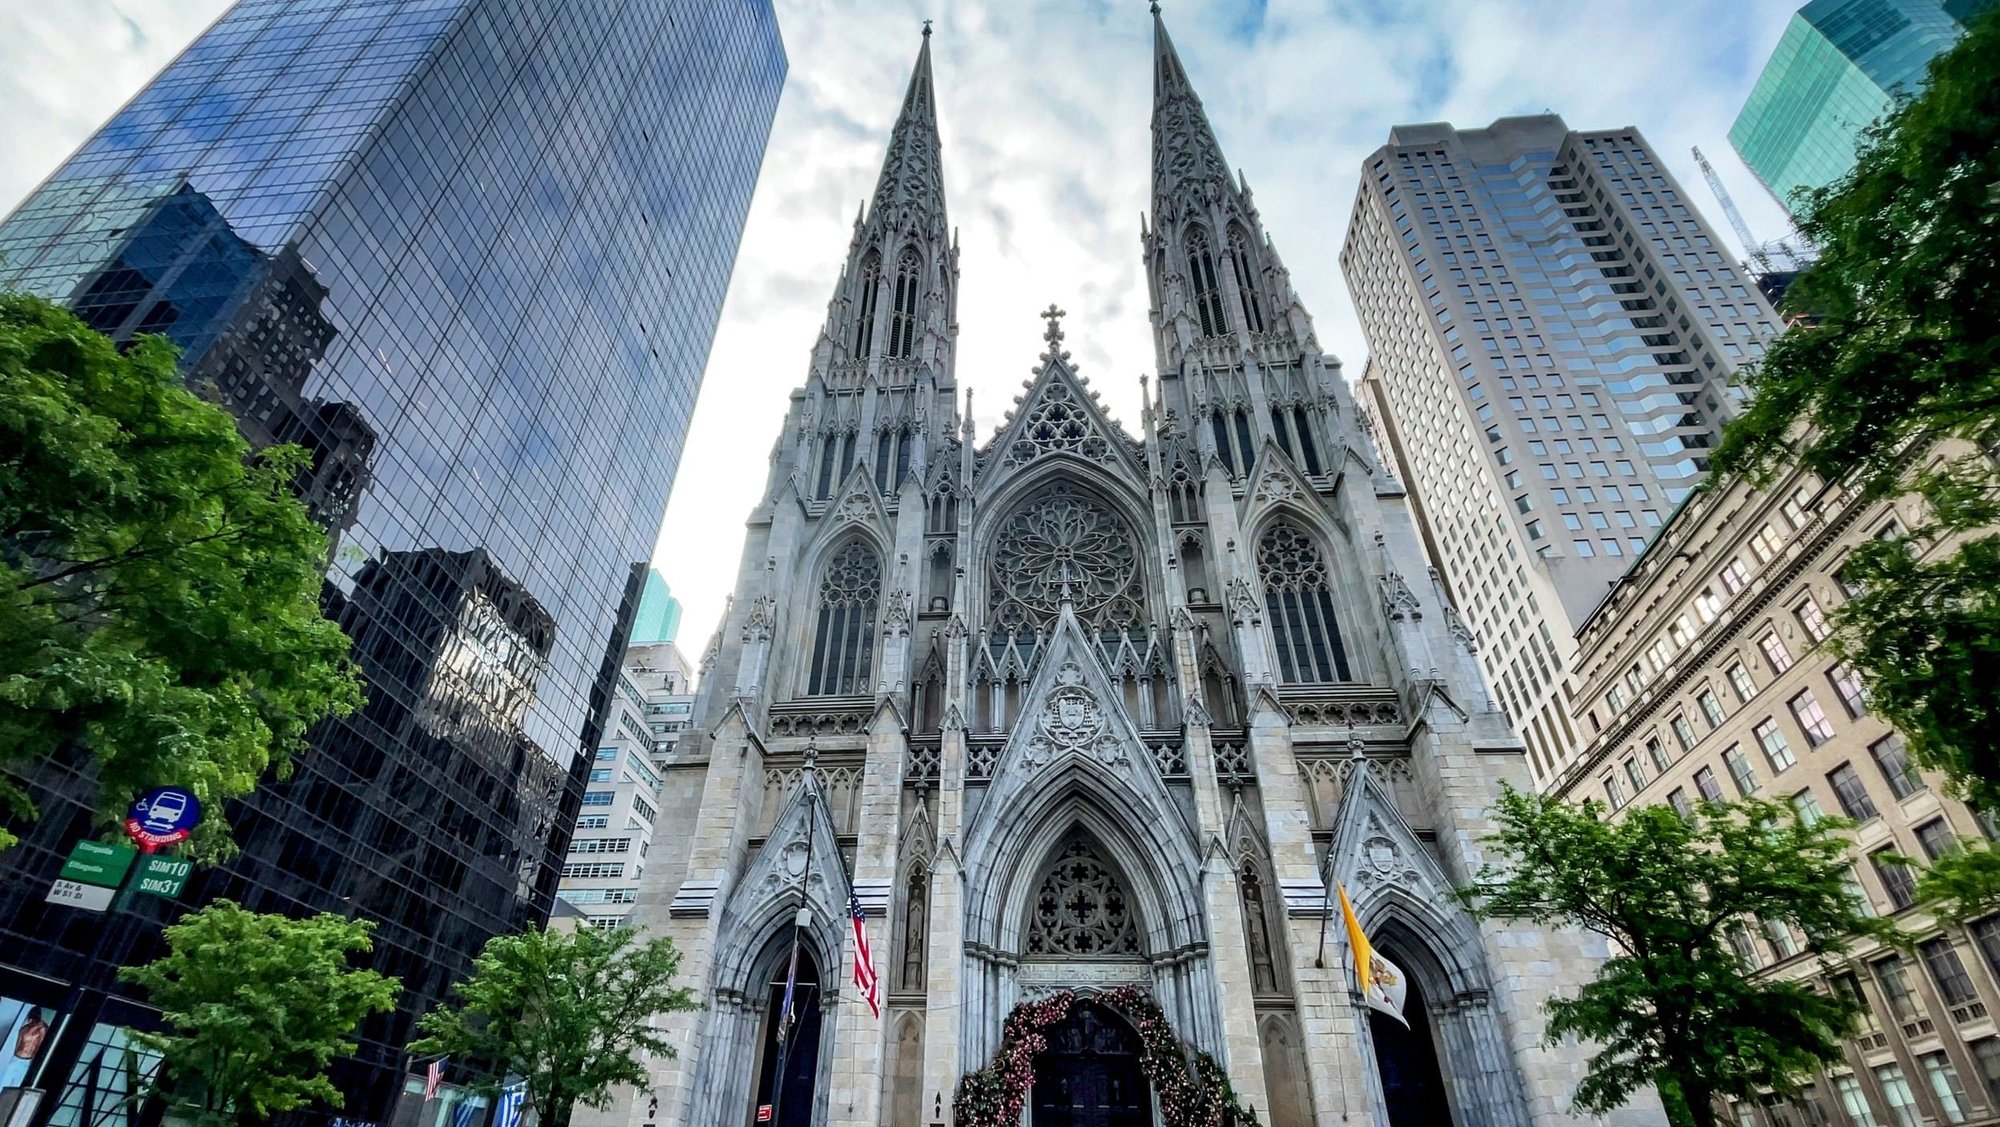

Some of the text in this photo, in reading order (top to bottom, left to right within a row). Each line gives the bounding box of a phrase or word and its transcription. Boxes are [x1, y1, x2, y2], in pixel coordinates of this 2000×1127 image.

[129, 822, 183, 843] NO STANDING
[148, 860, 189, 877] SIM10
[140, 878, 180, 895] SIM31
